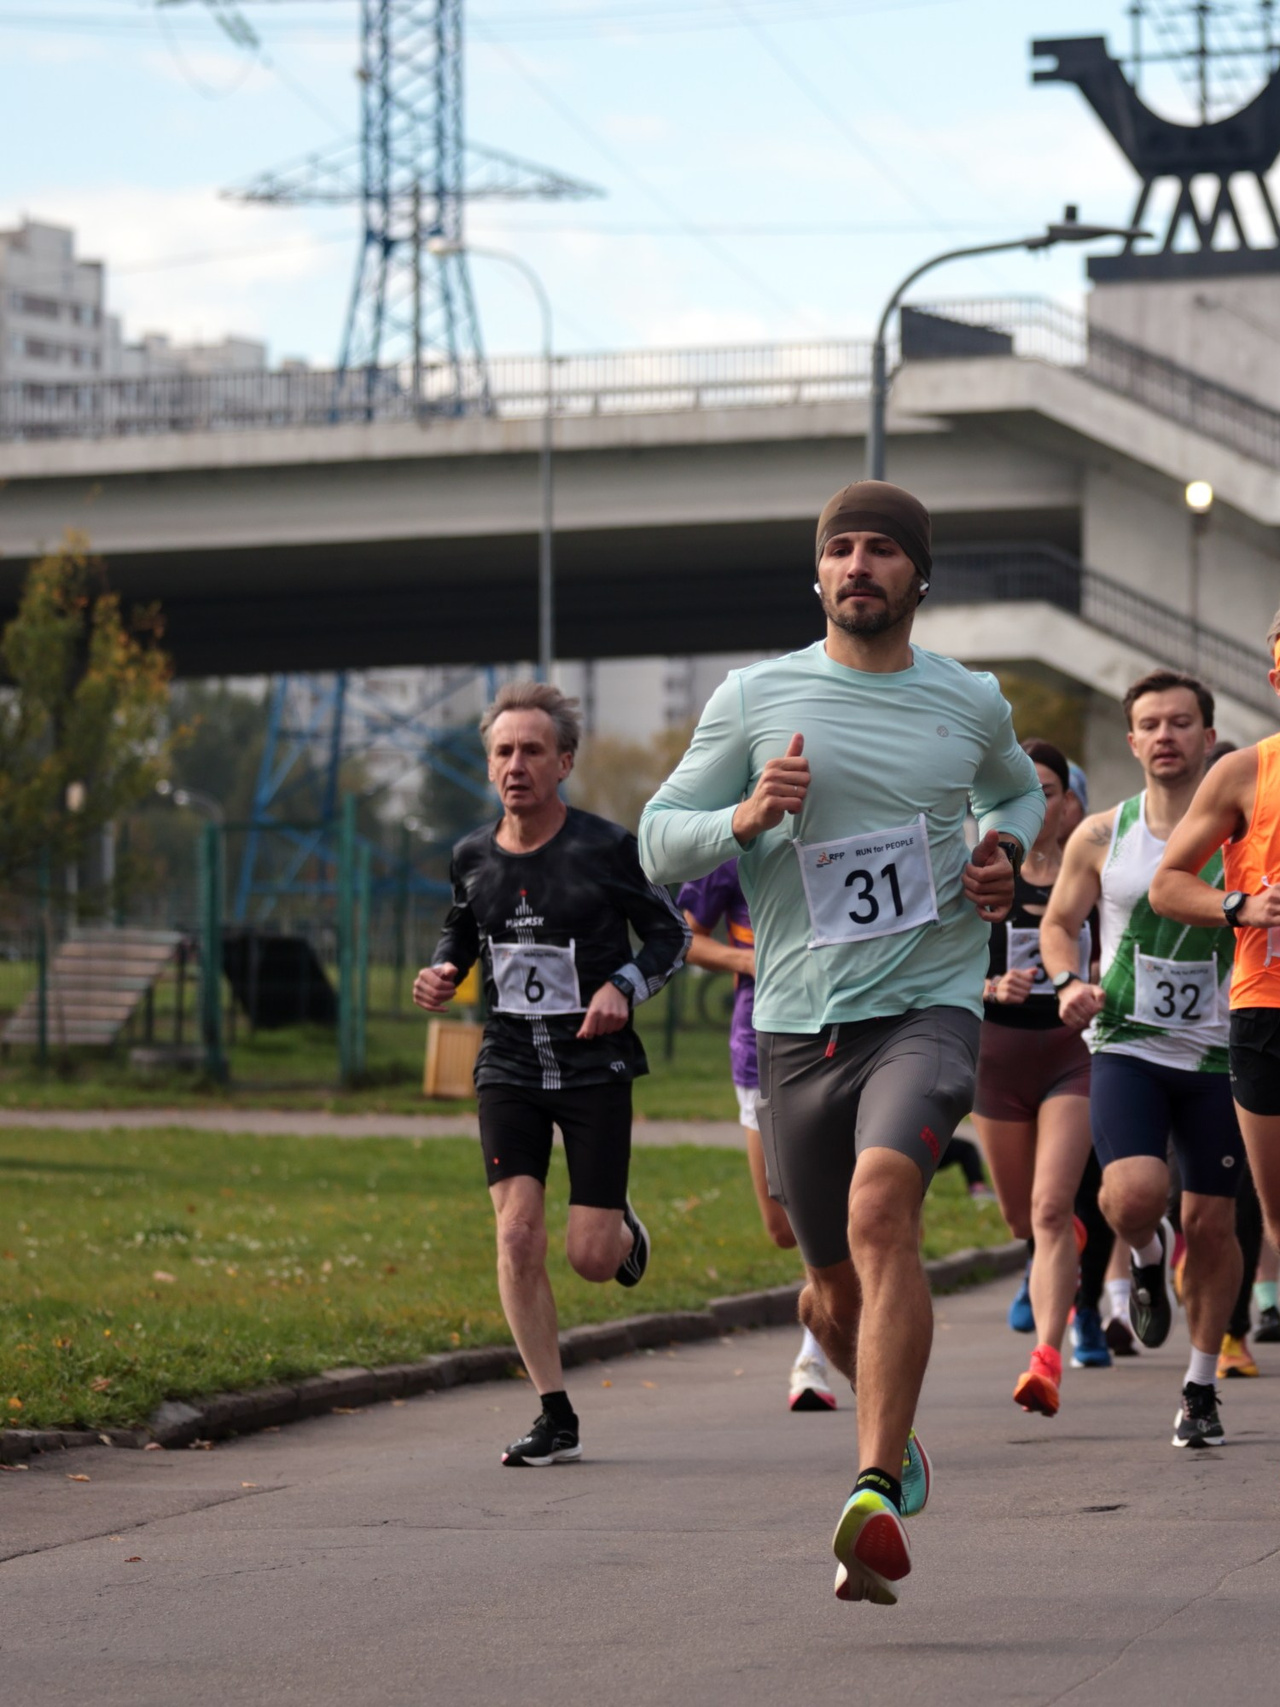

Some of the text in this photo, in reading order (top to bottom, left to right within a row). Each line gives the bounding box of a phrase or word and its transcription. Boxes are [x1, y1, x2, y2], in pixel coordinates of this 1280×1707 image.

[855, 848, 872, 857] RUN
[885, 838, 914, 850] PEOPLE
[845, 863, 903, 924] 31
[525, 966, 545, 1003] 6
[1154, 981, 1202, 1020] 32
